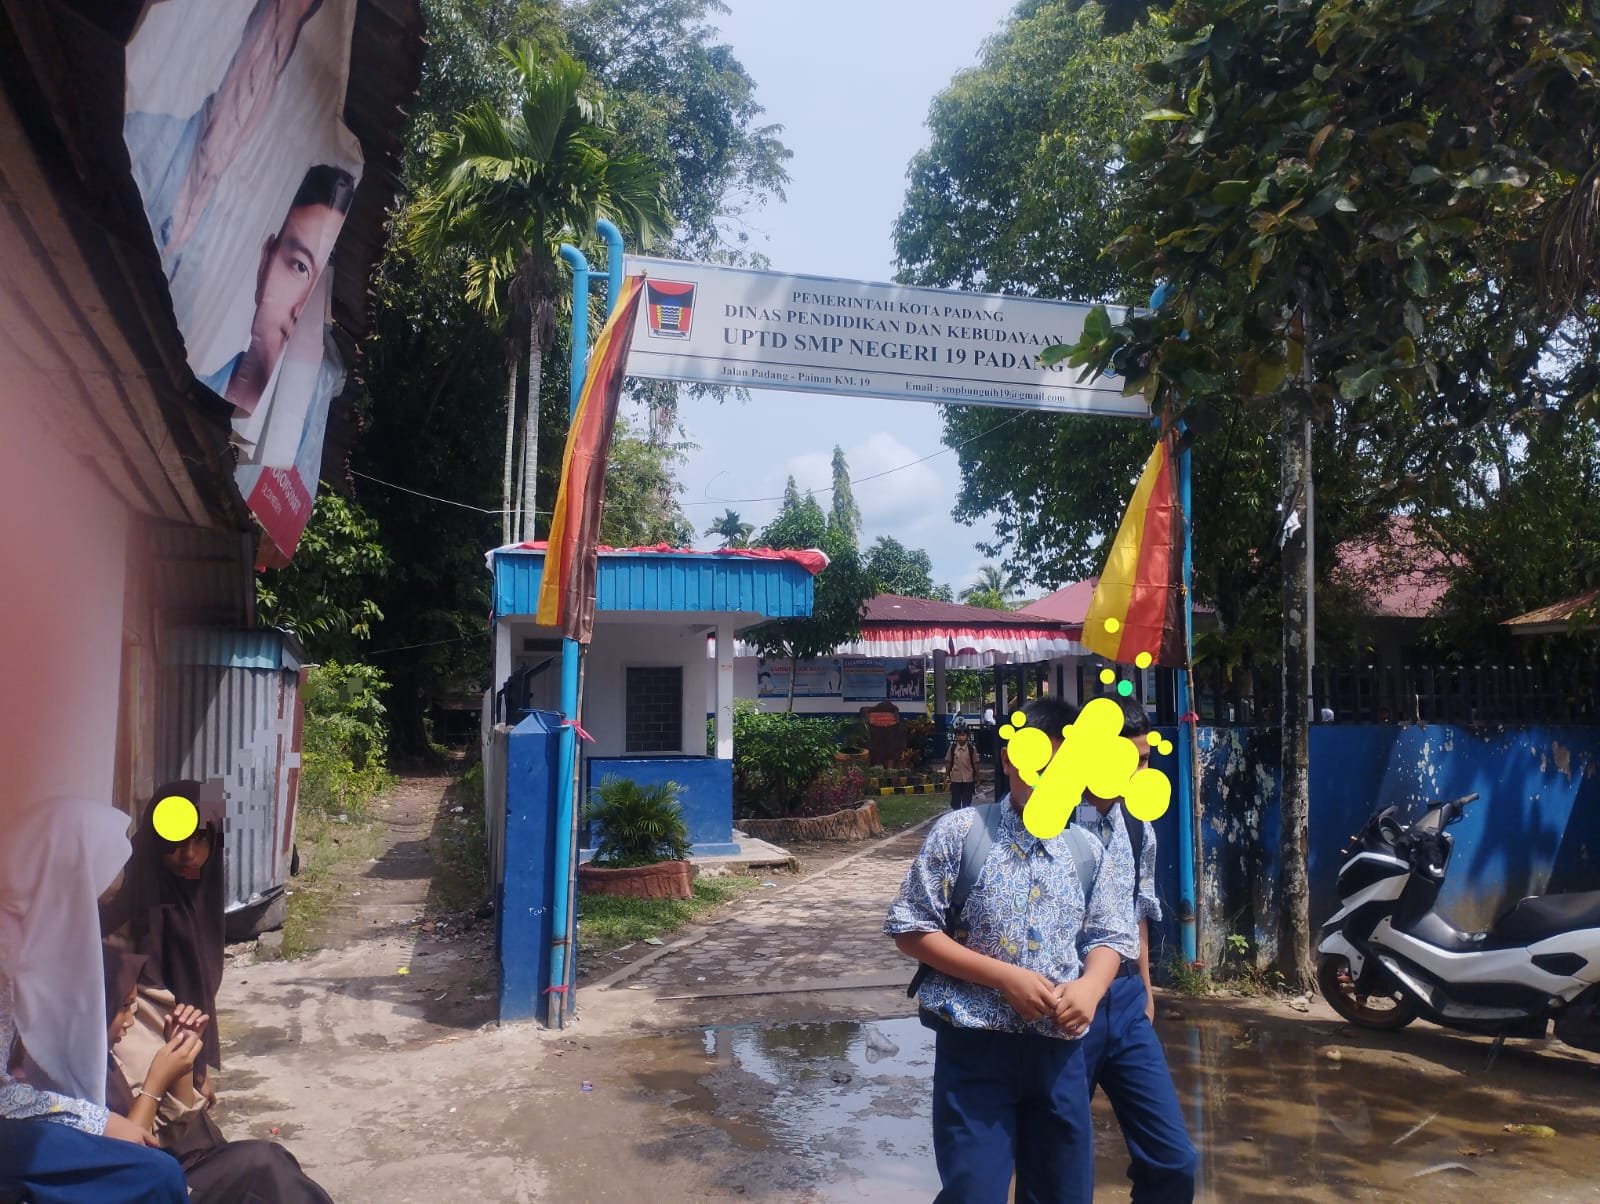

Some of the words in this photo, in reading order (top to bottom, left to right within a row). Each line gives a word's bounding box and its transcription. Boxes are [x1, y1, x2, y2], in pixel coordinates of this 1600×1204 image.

[792, 291, 895, 312] PEMERINTAH
[899, 302, 940, 317] KOTA
[944, 306, 1005, 322] PADANG
[725, 304, 782, 321] DINAS
[787, 310, 901, 333] PENDIDIKAN
[906, 321, 942, 337] DAN
[947, 325, 1064, 346] KEBUDAYAAN
[724, 327, 788, 349] UPTD
[794, 334, 844, 354] SMP
[849, 339, 938, 362] NEGERI
[946, 347, 967, 365] 19
[720, 366, 748, 377] Jalan
[751, 368, 789, 381] Padang
[798, 372, 832, 384] Painan
[835, 375, 857, 386] KM.
[860, 377, 871, 387] 19
[905, 381, 933, 392] Email
